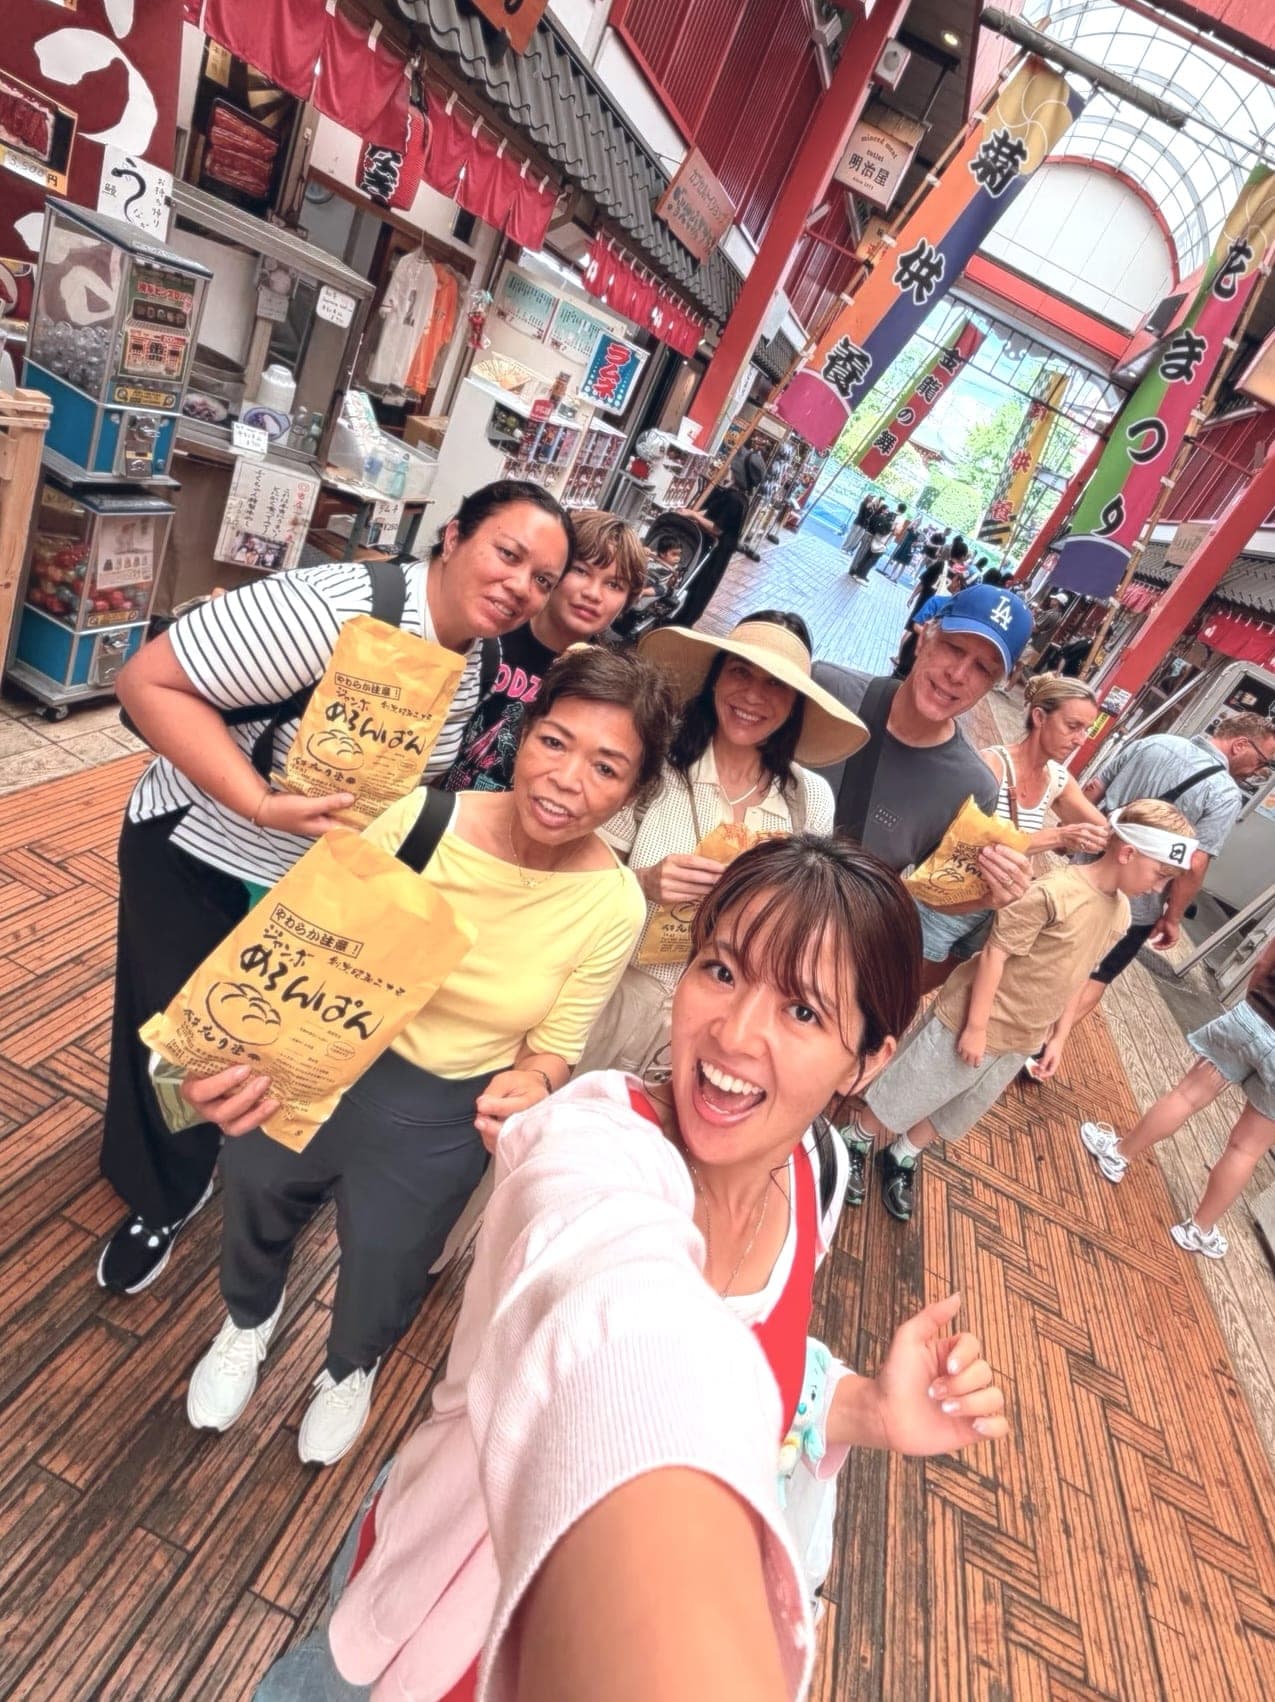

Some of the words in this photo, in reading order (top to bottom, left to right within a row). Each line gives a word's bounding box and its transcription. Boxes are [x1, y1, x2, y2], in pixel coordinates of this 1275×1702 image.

[848, 155, 889, 187] 明治屋
[821, 128, 1028, 398] 菊供養
[592, 342, 631, 401] ラムネ
[872, 348, 965, 456] 金龍の舞
[1090, 239, 1255, 537] 花まつり
[990, 595, 1012, 631] LA
[273, 907, 361, 957] やわらか注意！
[239, 943, 385, 1040] めろんぱん
